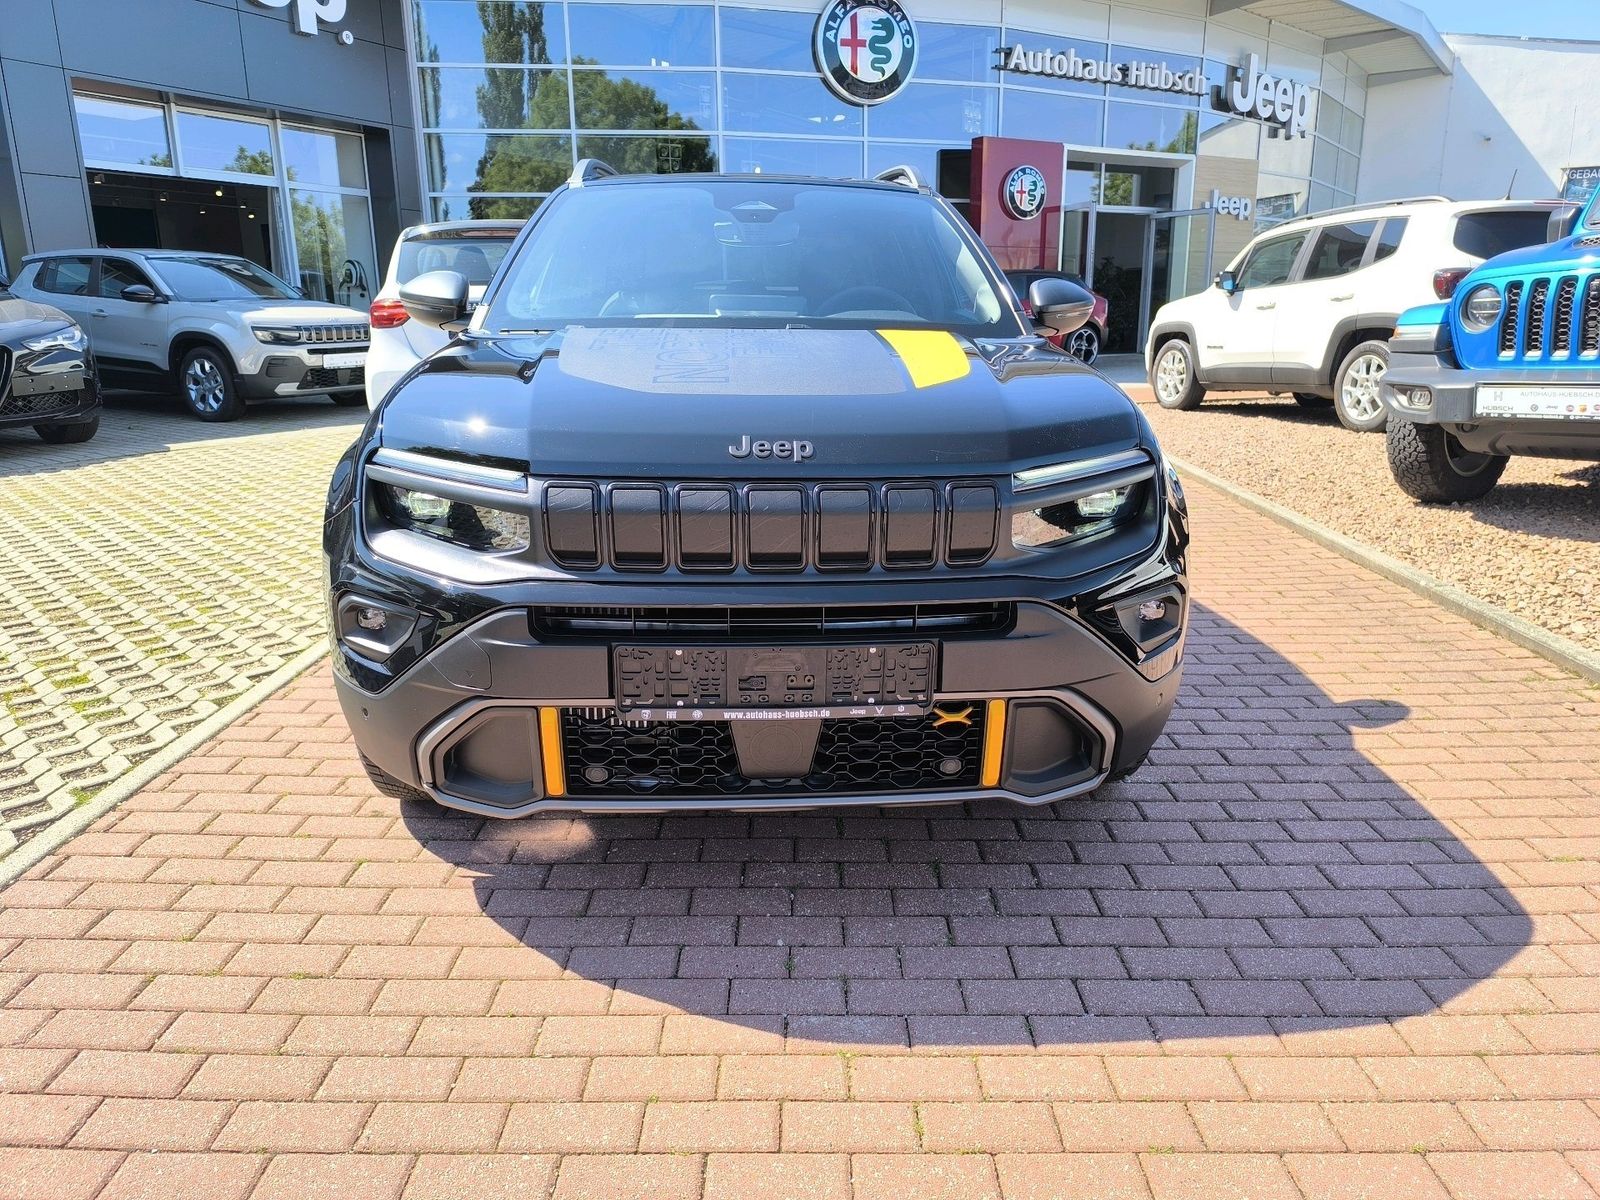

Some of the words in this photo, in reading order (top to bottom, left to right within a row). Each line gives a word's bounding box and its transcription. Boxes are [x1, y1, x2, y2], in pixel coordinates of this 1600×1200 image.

[825, 0, 858, 43] ALFA
[1007, 43, 1122, 83] Autohaus
[1128, 60, 1206, 95] Hübsch
[1232, 53, 1311, 137] Jeep
[1204, 188, 1252, 220] Jeep
[728, 435, 814, 463] Jeep
[723, 709, 830, 720] www.autohaus-huebsch.de
